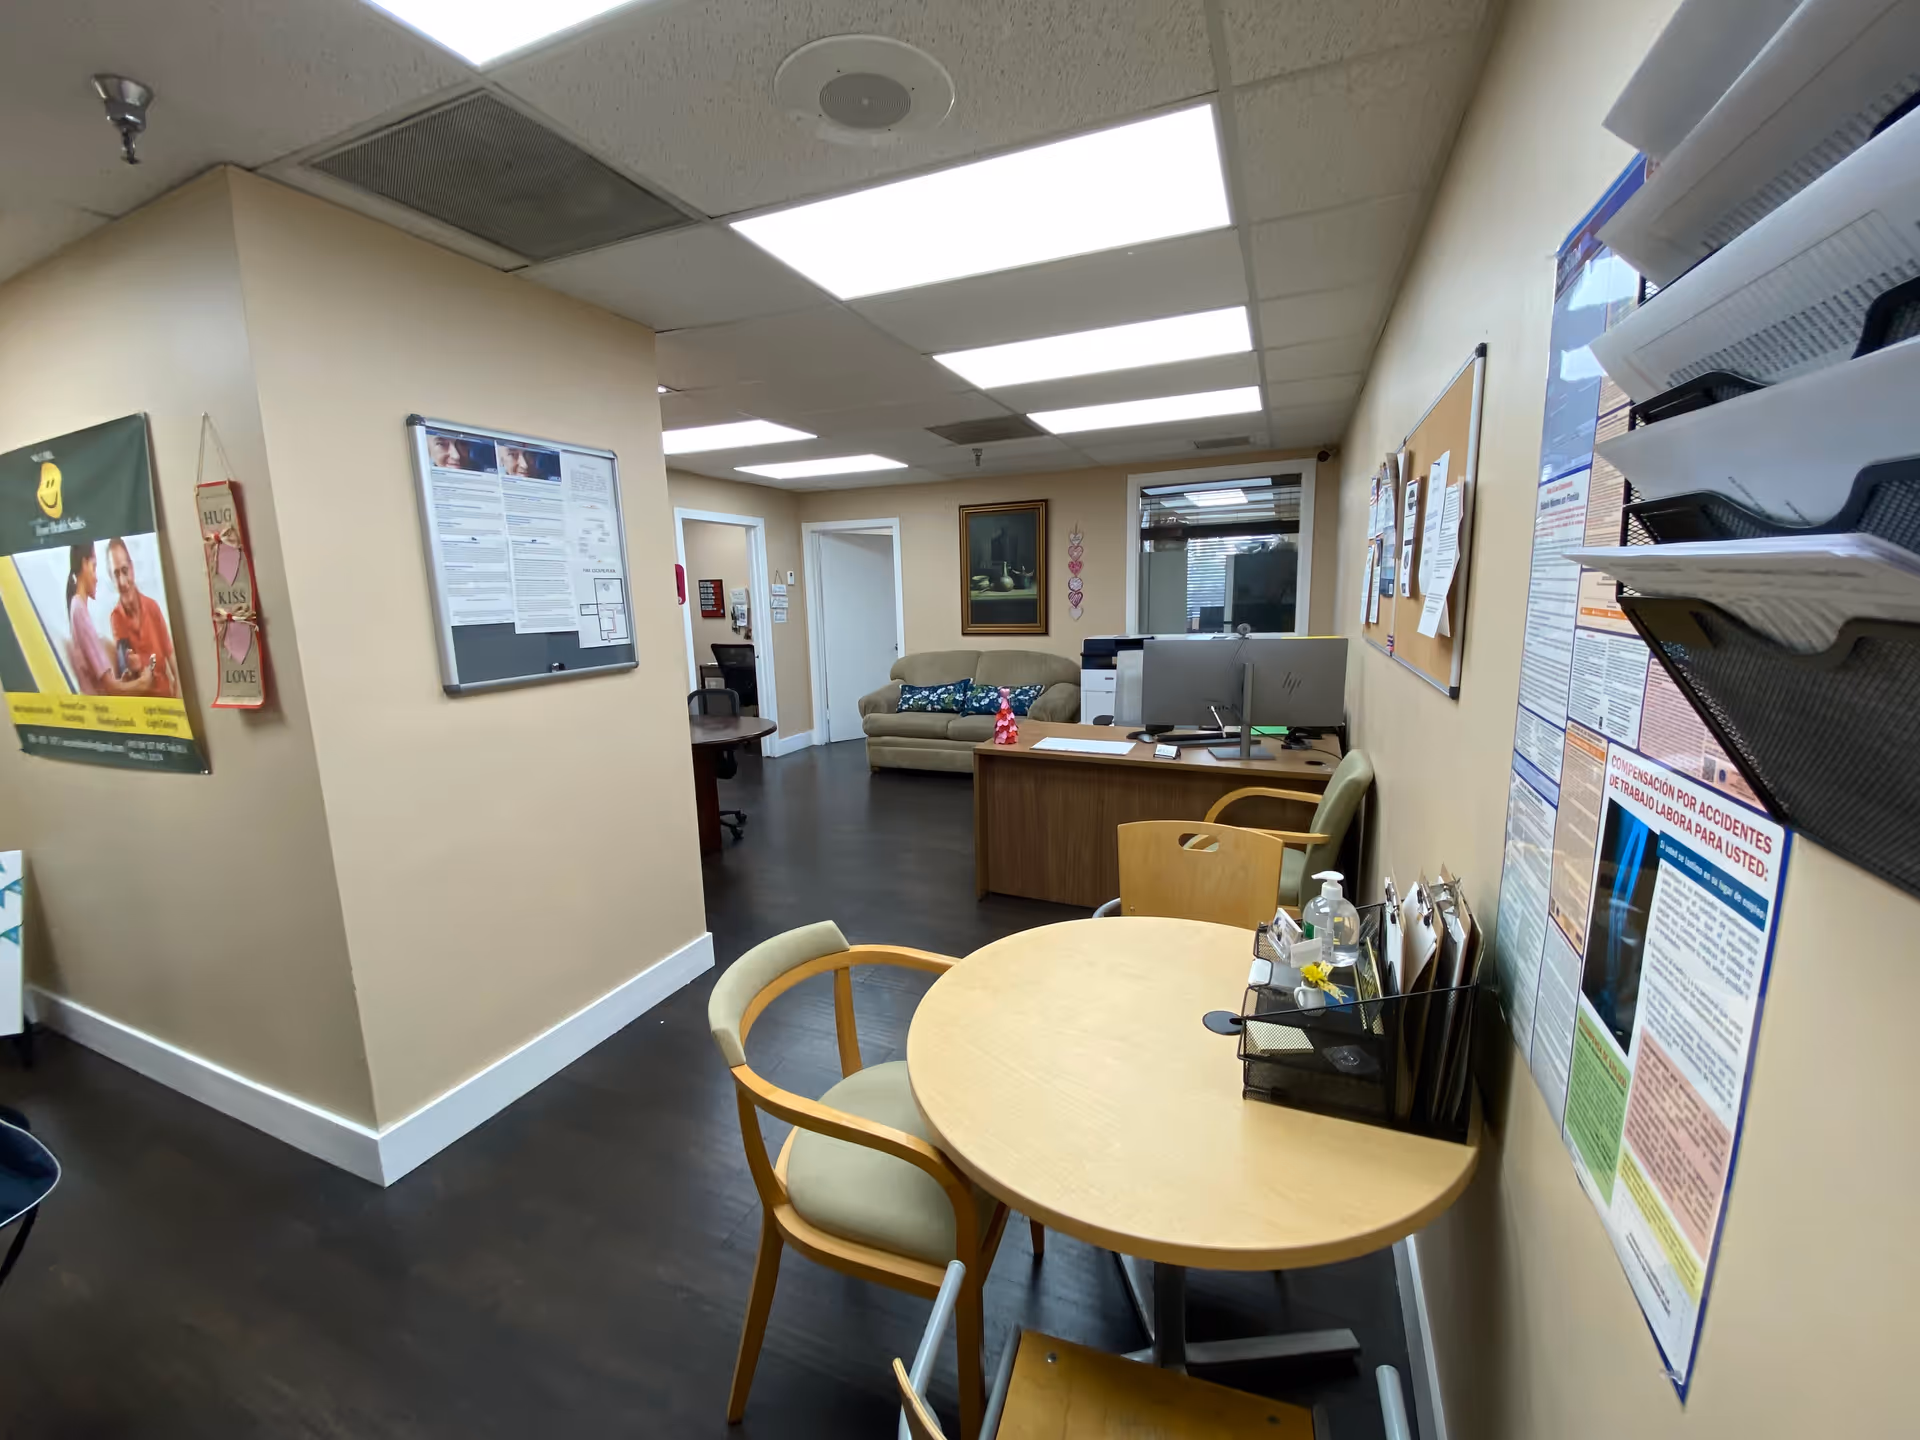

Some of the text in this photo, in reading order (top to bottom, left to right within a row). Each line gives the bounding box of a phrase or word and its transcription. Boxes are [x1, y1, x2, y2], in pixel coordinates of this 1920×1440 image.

[204, 508, 232, 525] HUG
[218, 591, 246, 605] KISS
[226, 669, 257, 684] LOVE
[1611, 754, 1772, 855] COMPENSACIÓN POR ACCIDENTES
[1609, 773, 1768, 882] DE TRABAJO LABORA PARA USTED:
